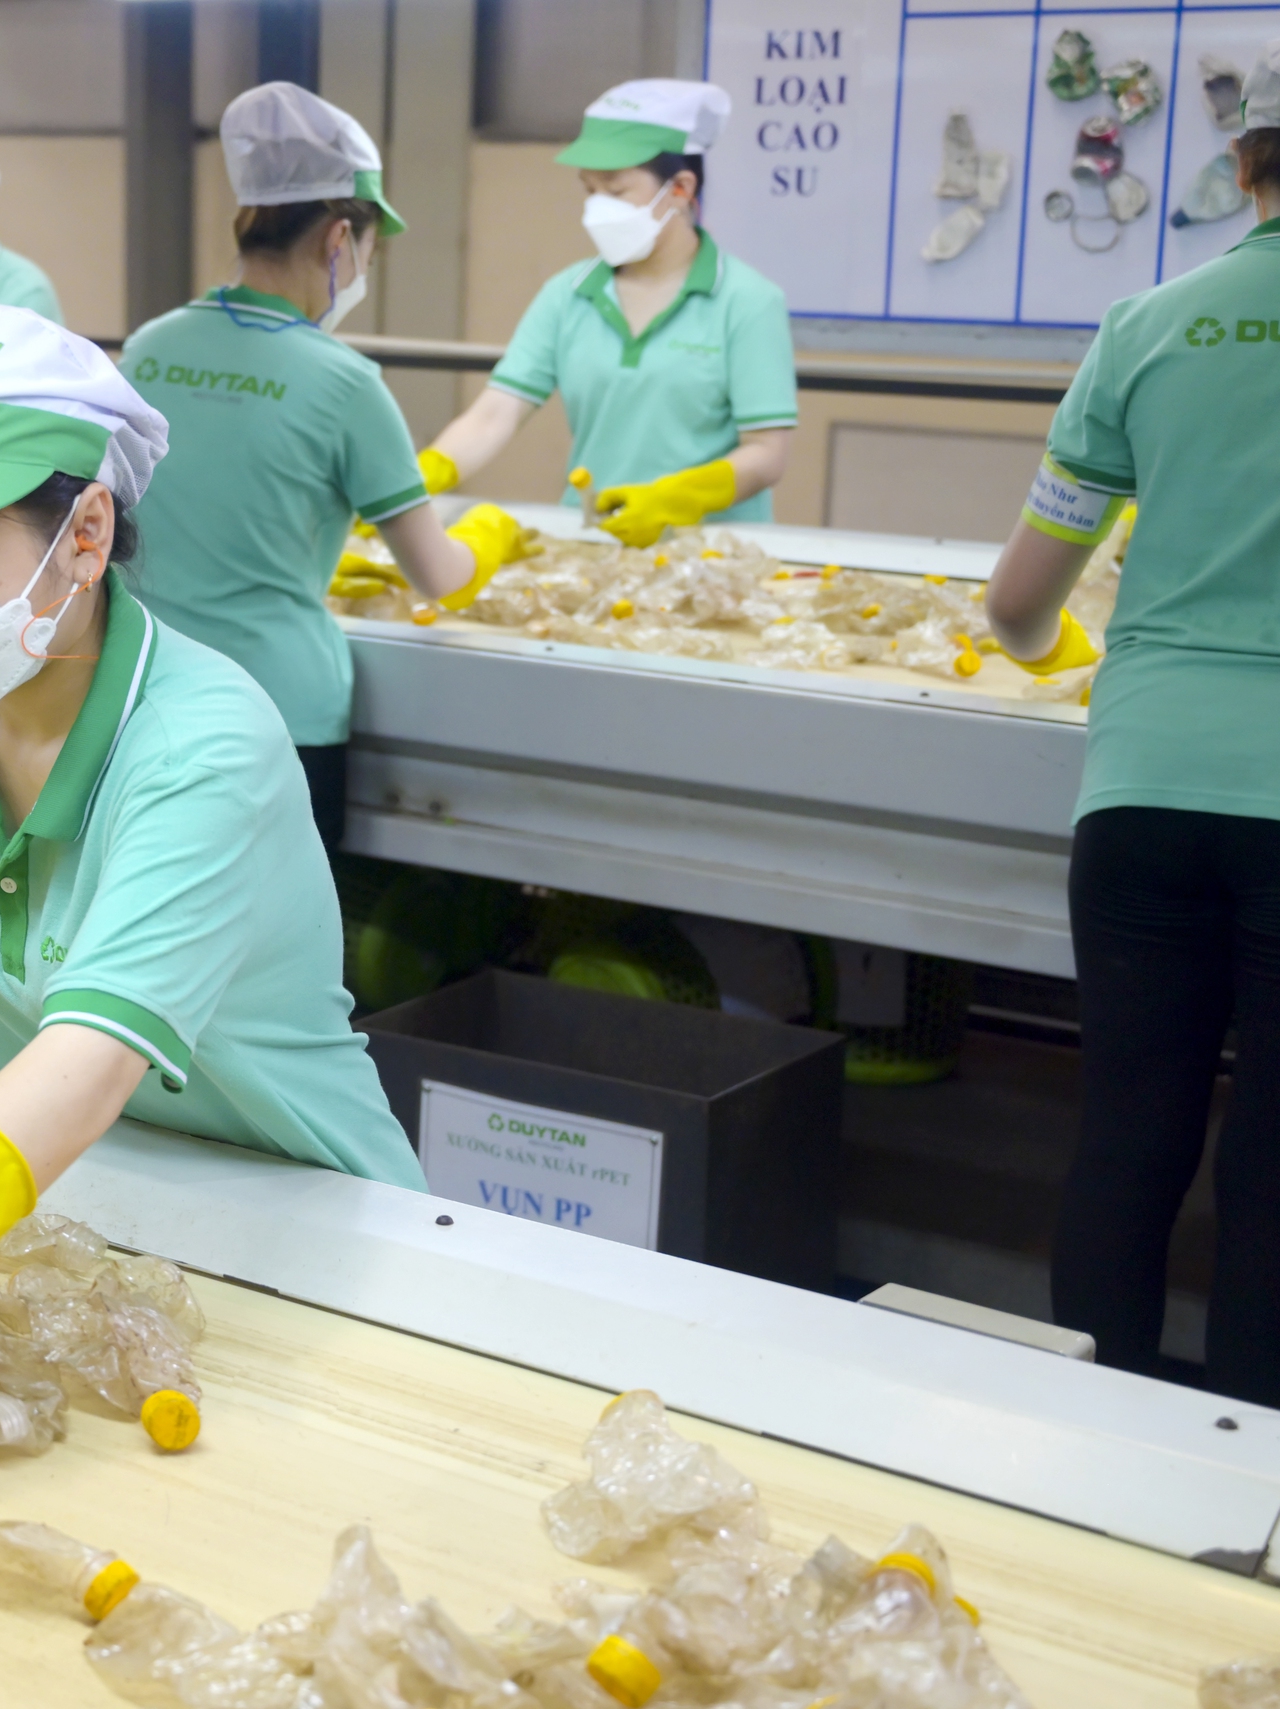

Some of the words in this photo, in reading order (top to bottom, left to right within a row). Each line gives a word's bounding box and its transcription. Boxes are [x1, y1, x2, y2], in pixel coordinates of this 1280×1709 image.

[765, 29, 841, 60] KIM
[755, 75, 846, 114] LOẠI
[757, 120, 839, 151] CAO
[770, 165, 818, 197] SU
[165, 364, 287, 401] DUYTAN
[508, 1118, 586, 1148] DUYTAN
[556, 1197, 592, 1227] PP
